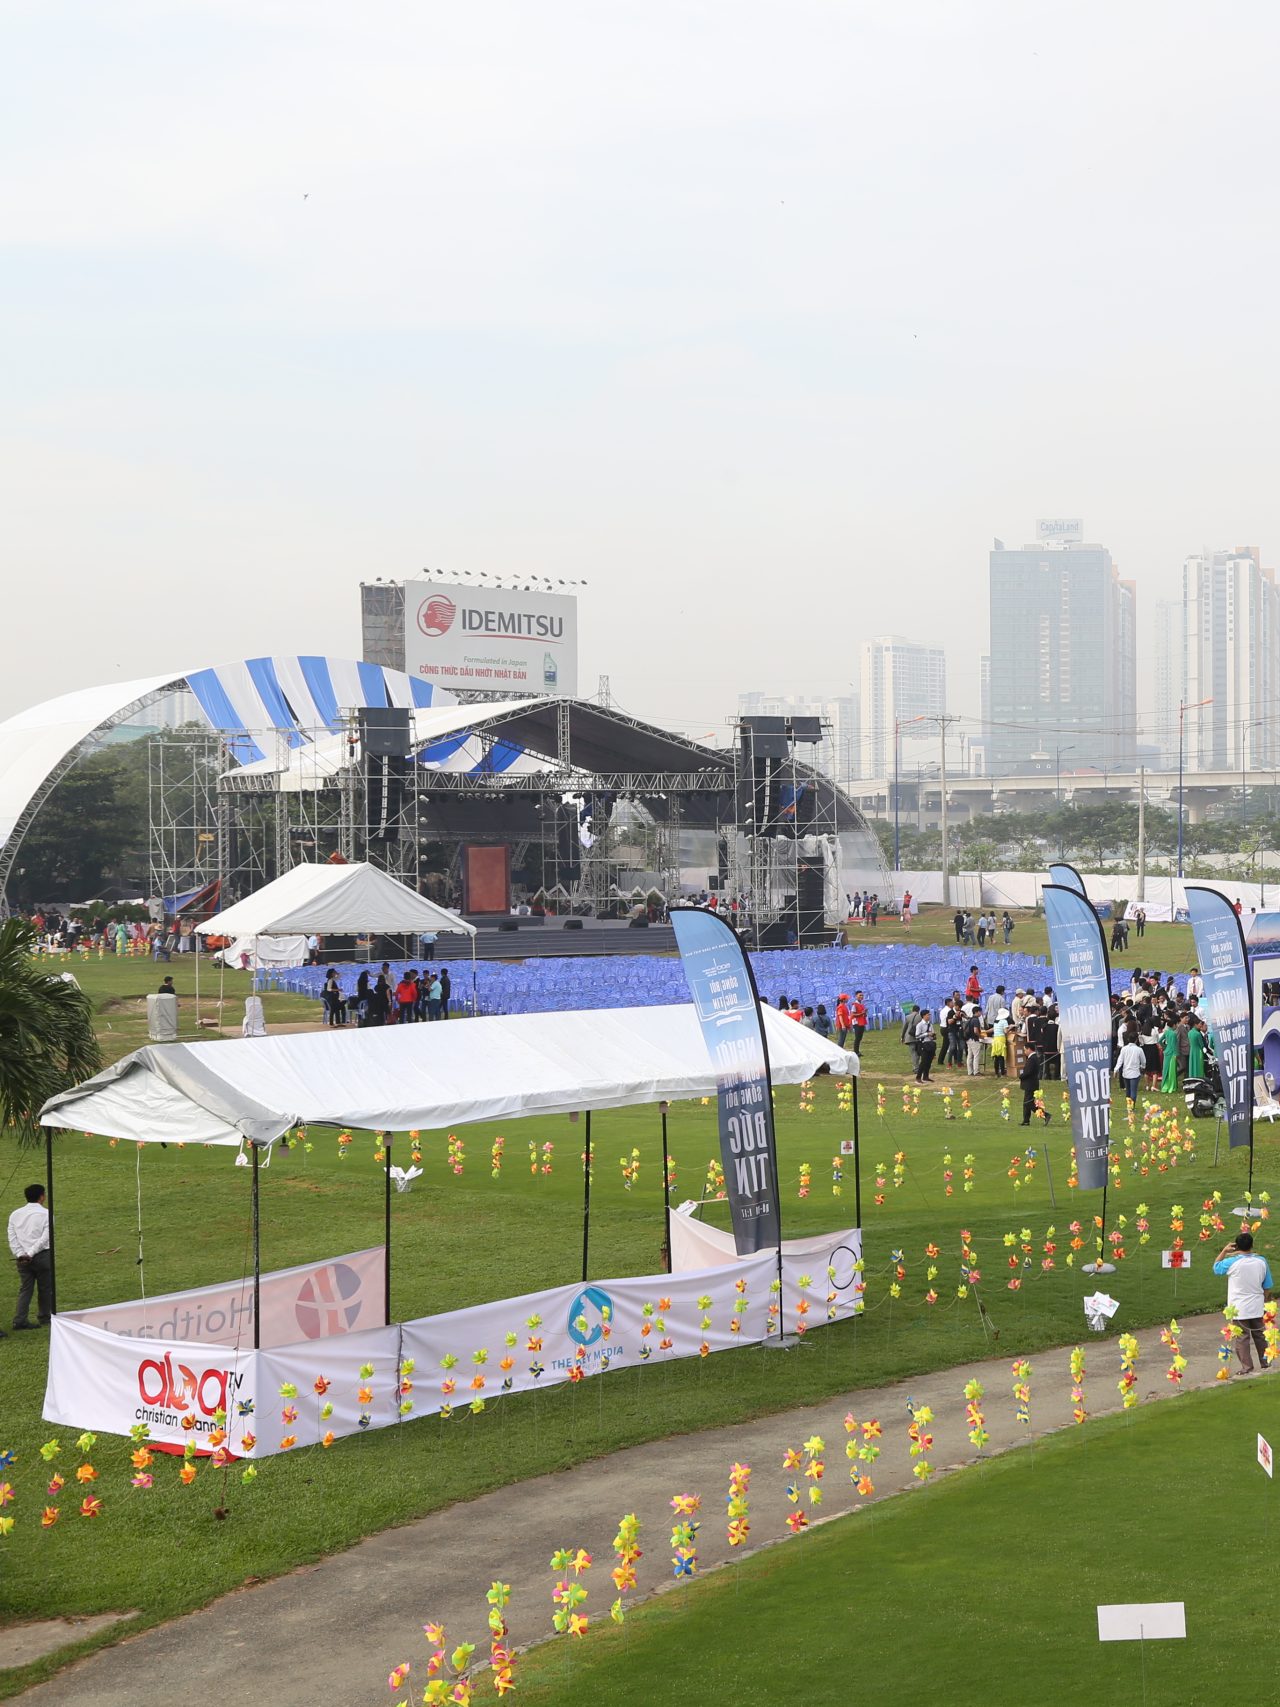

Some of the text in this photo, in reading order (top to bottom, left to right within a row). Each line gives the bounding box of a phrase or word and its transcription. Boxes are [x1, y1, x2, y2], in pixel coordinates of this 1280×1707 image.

[461, 608, 563, 637] IDEMITSU
[419, 663, 439, 675] CÔNG
[464, 655, 500, 665] Formulated
[508, 658, 527, 667] Japan
[551, 1357, 572, 1370] THE
[594, 1345, 623, 1361] MEDIA
[135, 1406, 178, 1427] christian
